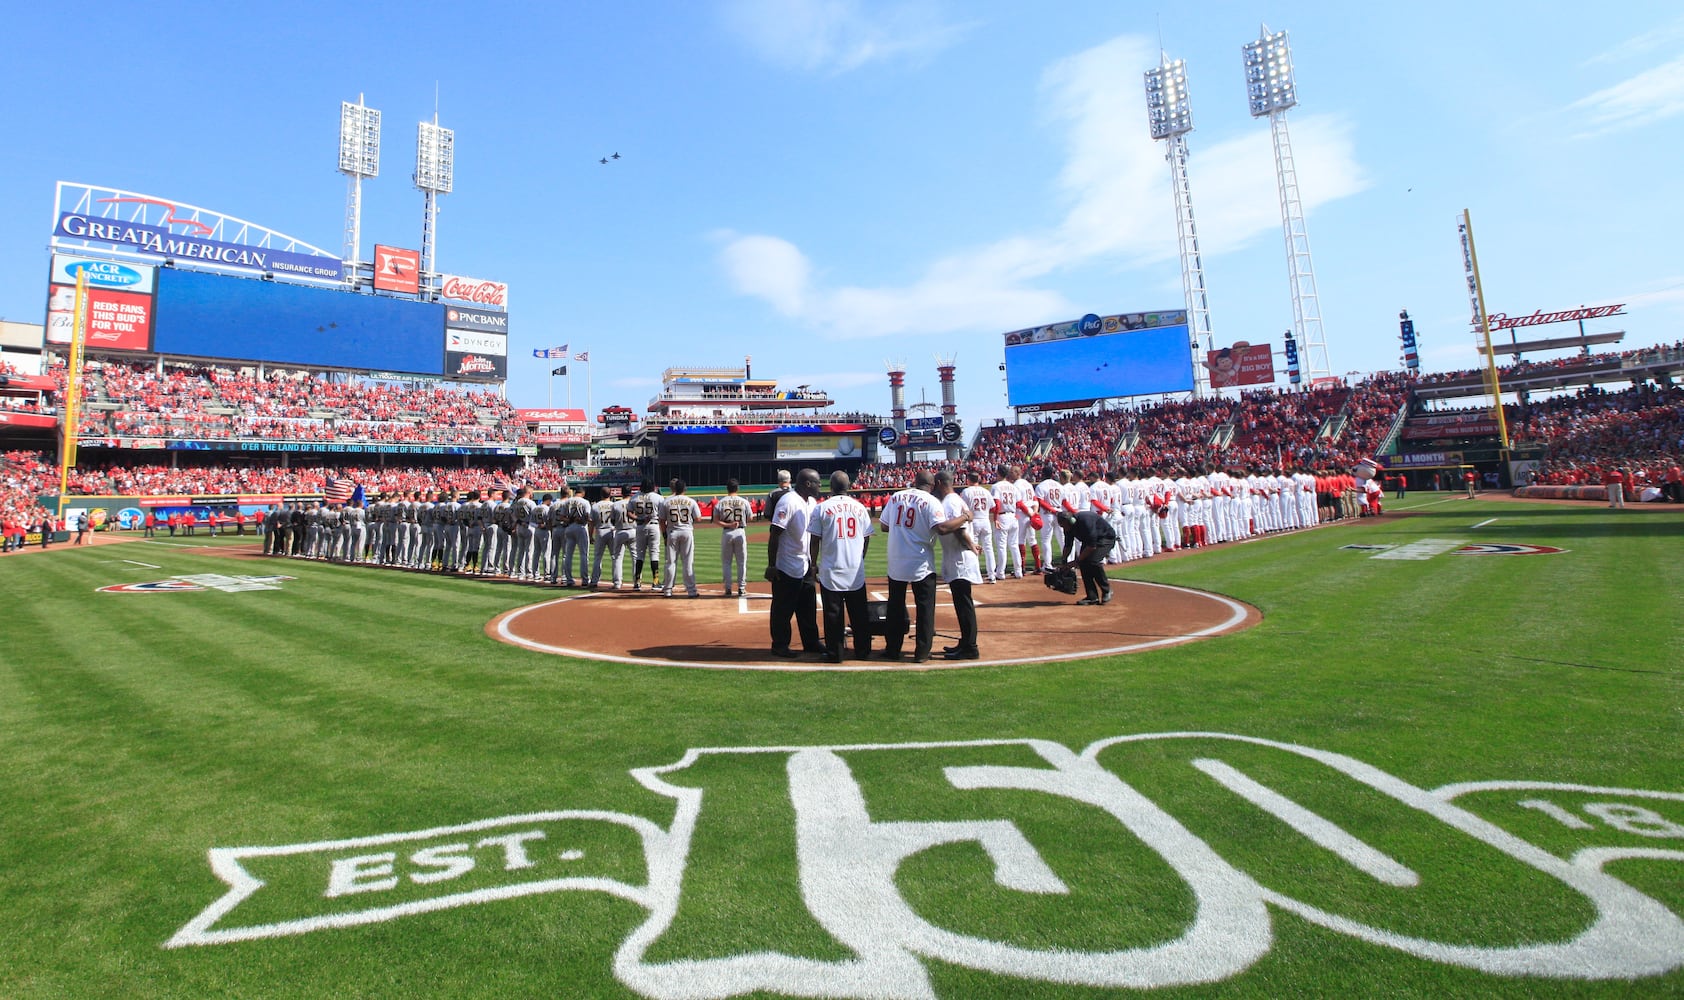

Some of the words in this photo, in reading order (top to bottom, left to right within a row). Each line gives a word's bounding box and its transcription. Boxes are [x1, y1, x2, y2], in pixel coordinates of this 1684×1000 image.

[89, 263, 120, 274] ACR
[272, 261, 313, 273] INSURANCE
[314, 267, 338, 277] GROUP
[76, 270, 131, 284] ONCRETE
[93, 301, 118, 312] REDS
[120, 303, 146, 316] FANS,
[93, 310, 117, 321] THIS
[117, 313, 145, 324] BUD'S
[459, 312, 480, 323] PNC
[480, 314, 506, 327] BANK
[92, 320, 111, 330] FOR
[113, 322, 135, 332] YOU.
[1084, 320, 1101, 331] P&G
[464, 338, 501, 348] DYNEGY
[1241, 364, 1255, 373] BIG
[1255, 362, 1272, 371] BOY
[242, 442, 259, 451] O'ER
[262, 443, 277, 451] THE
[278, 443, 299, 451] LAND
[301, 443, 311, 452] OF
[312, 443, 327, 452] THE
[328, 444, 345, 452] FREE
[346, 445, 362, 453] AND
[364, 445, 378, 453] THE
[379, 445, 398, 454] HOME
[400, 446, 408, 454] OF
[410, 446, 422, 454] THE
[423, 446, 444, 454] BRAVE
[1404, 455, 1411, 463] A
[1412, 453, 1445, 463] MONTH
[892, 493, 928, 509] MISTICS
[1002, 492, 1014, 505] 33
[1049, 488, 1060, 501] 66
[825, 503, 864, 516] MISTICS
[973, 497, 987, 511] 25
[669, 508, 690, 523] 53
[723, 508, 743, 521] 26
[895, 505, 916, 529] 19
[836, 517, 857, 539] 19
[324, 830, 588, 898] EST.
